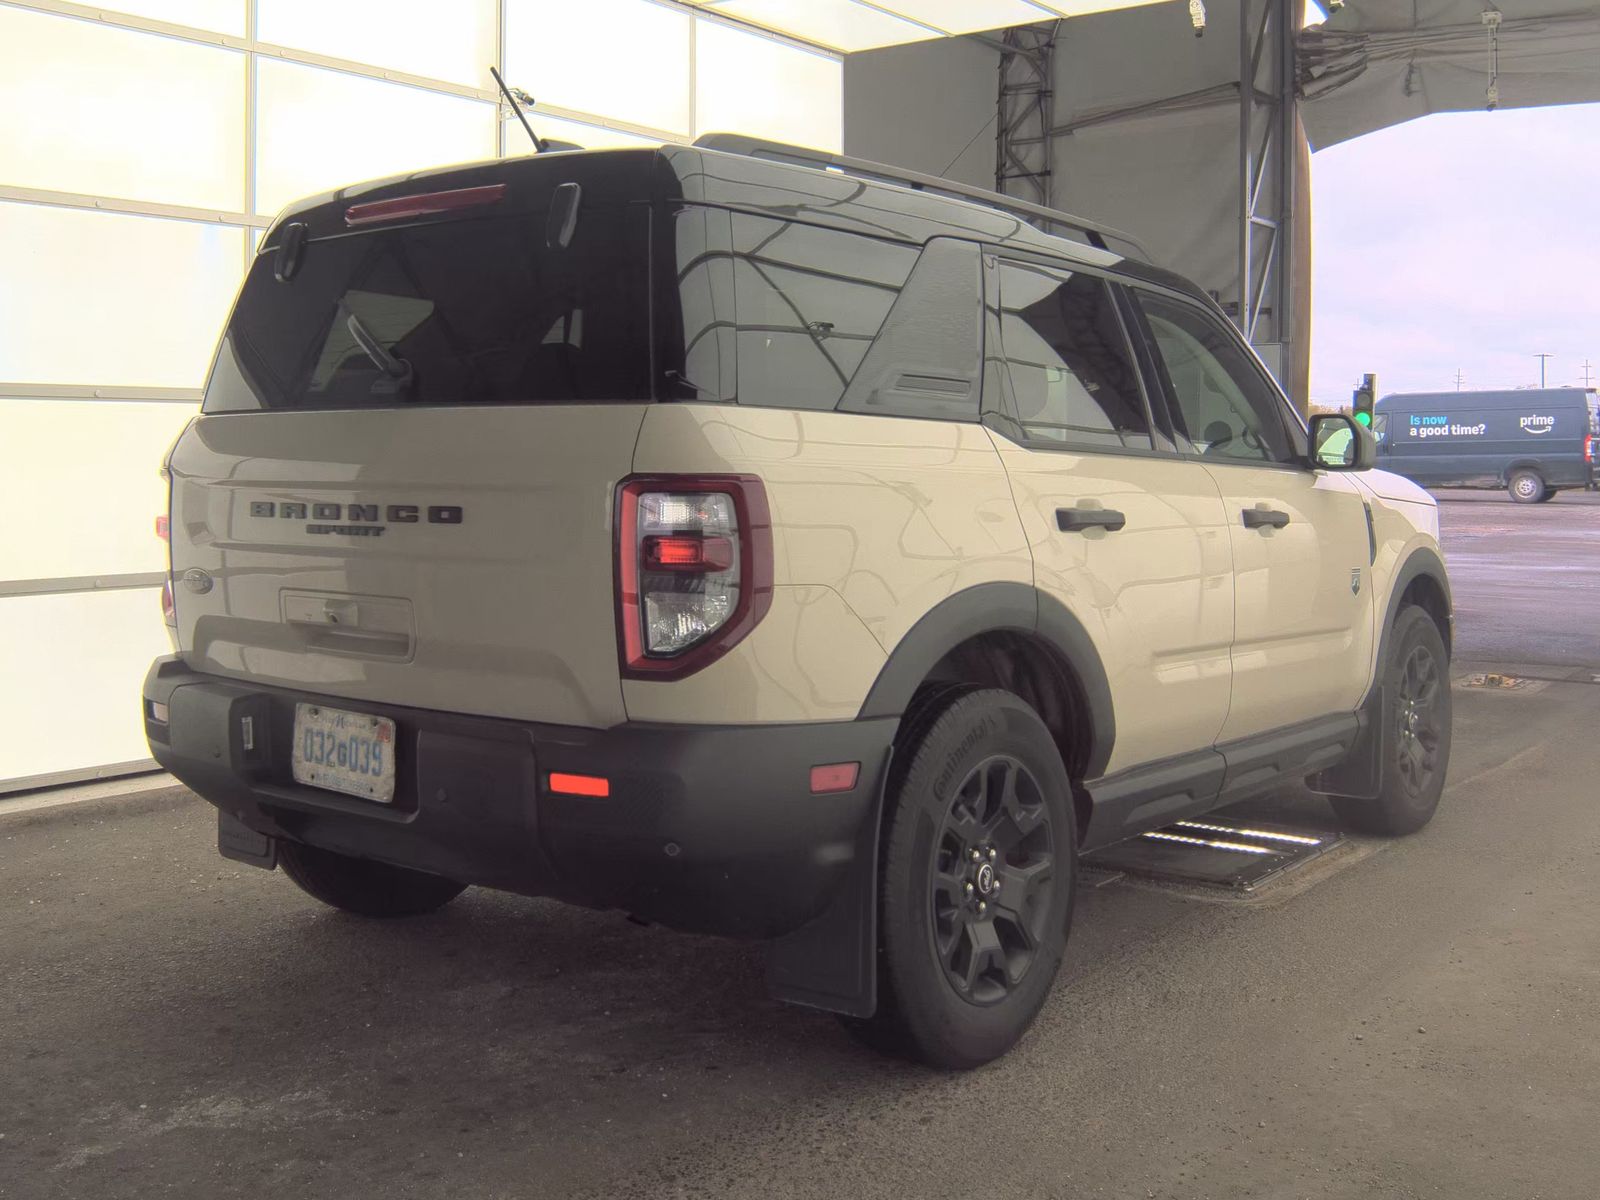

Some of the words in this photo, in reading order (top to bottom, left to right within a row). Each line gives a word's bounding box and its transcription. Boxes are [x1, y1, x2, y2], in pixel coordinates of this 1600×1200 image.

[1410, 415, 1421, 426] Is
[1422, 416, 1448, 425] now
[1520, 414, 1555, 428] prime
[1409, 427, 1418, 436] a
[1419, 424, 1449, 438] good
[1450, 423, 1486, 436] time?
[250, 501, 463, 524] BRONCO
